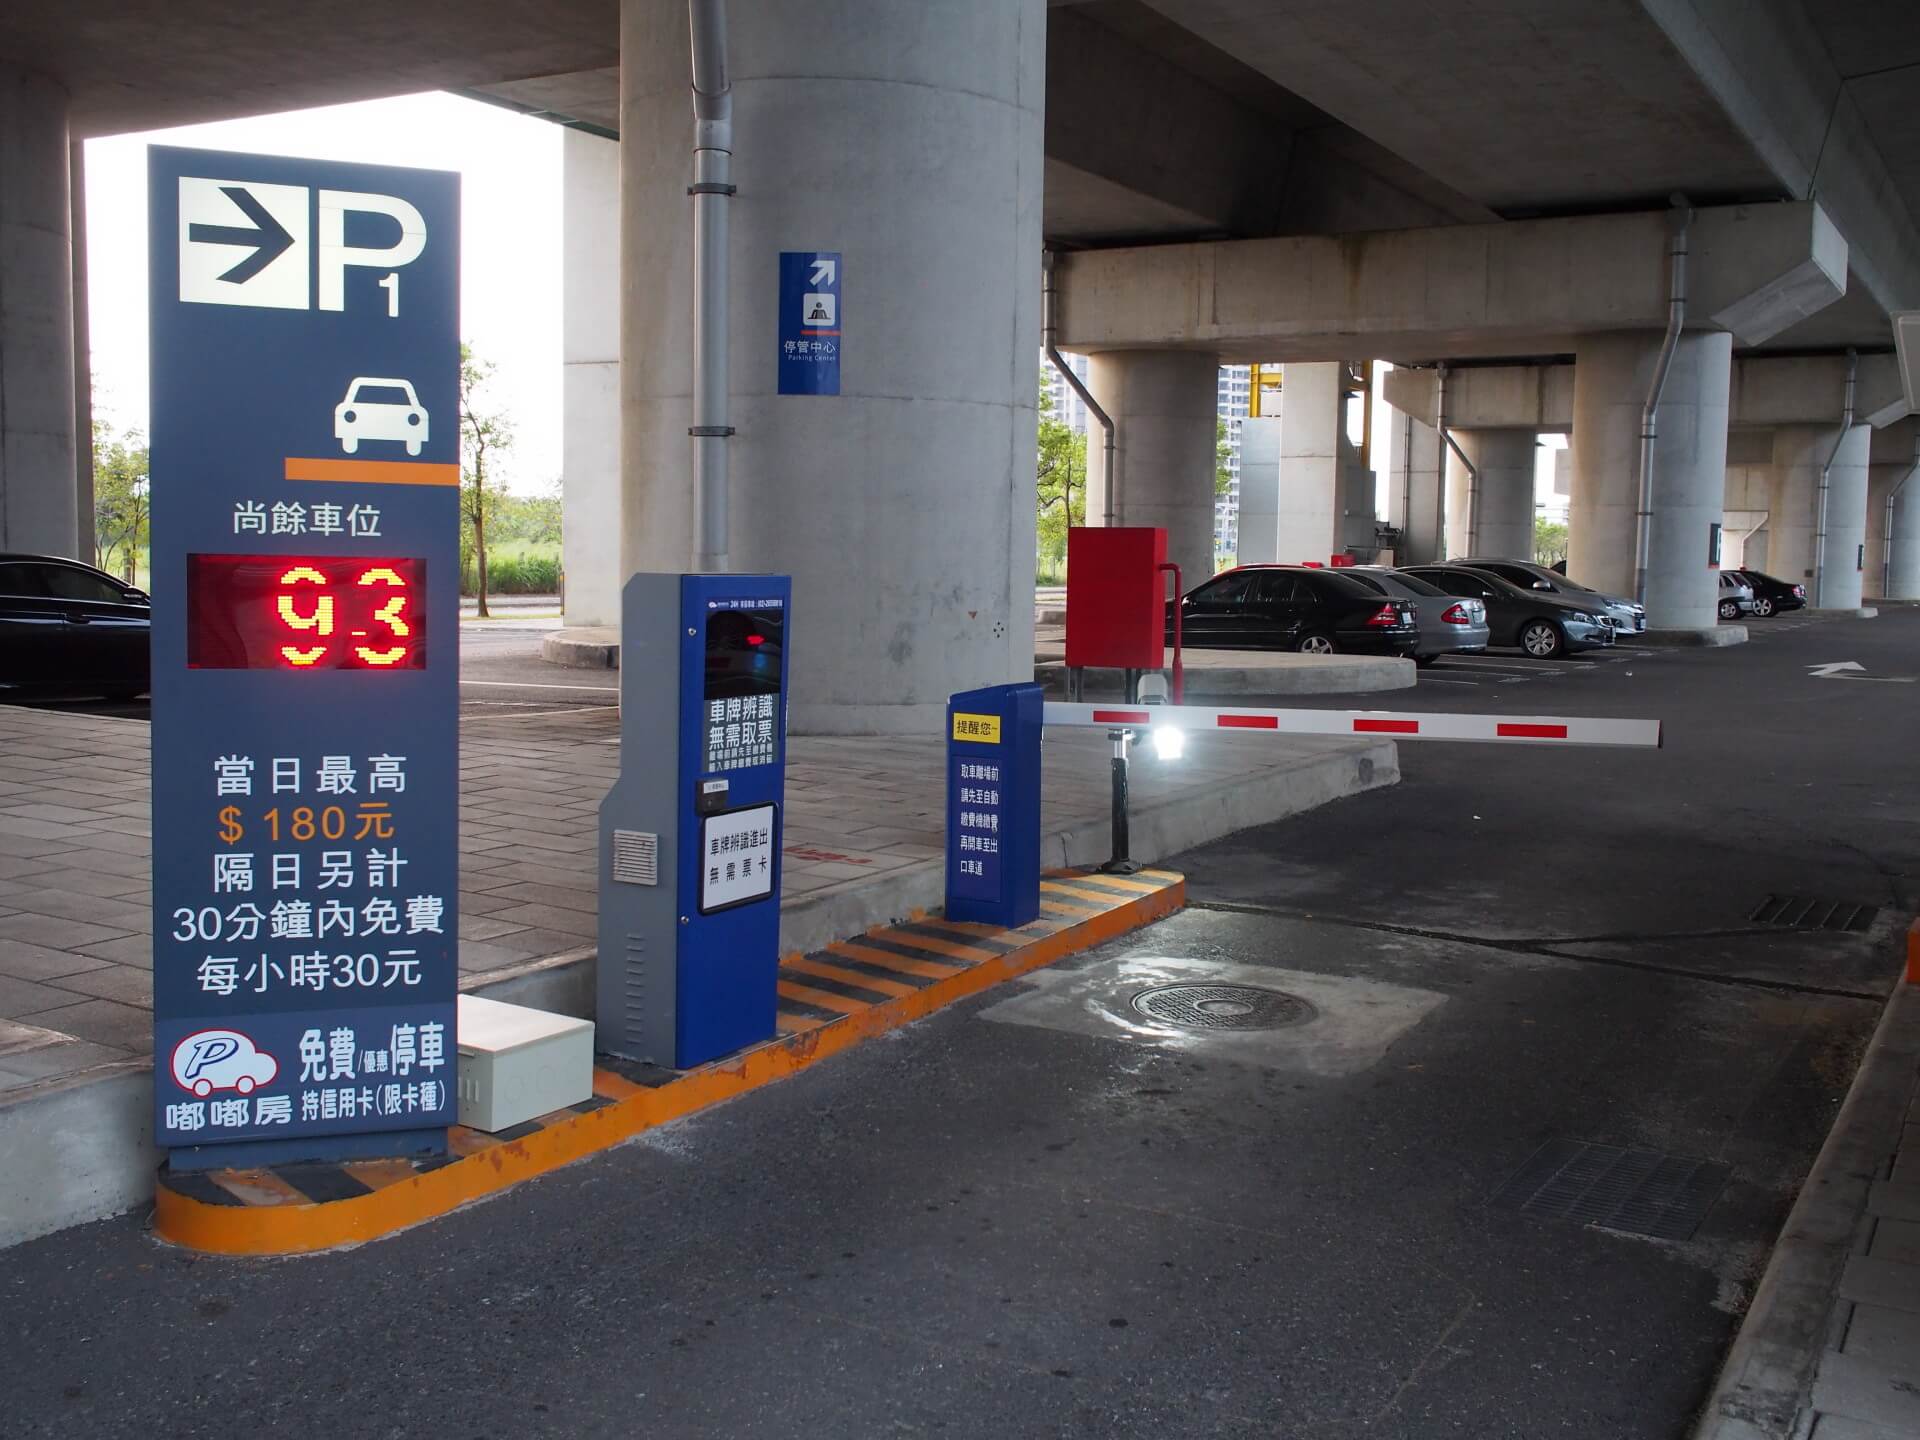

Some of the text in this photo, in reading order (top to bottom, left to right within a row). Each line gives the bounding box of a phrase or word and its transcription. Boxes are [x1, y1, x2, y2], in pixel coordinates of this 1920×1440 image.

[784, 341, 836, 353] 停管中心
[233, 500, 382, 538] 尚餘車位
[277, 566, 410, 665] 93
[709, 694, 773, 724] 車牌辨識
[709, 719, 773, 750] 無需取票
[213, 752, 408, 797] 當日最高
[961, 763, 999, 782] 取車離場前
[960, 787, 999, 805] 請先至自動
[710, 827, 768, 857] 車牌辨識進出
[960, 834, 998, 853] 再開車至出
[213, 847, 409, 894] 隔日另計
[709, 855, 768, 886] 無需票卡
[960, 860, 983, 876] 口車道
[172, 894, 445, 943] 30分鐘內免費
[197, 948, 423, 996] 每小時30元
[165, 1094, 293, 1132] 嘟嘟房
